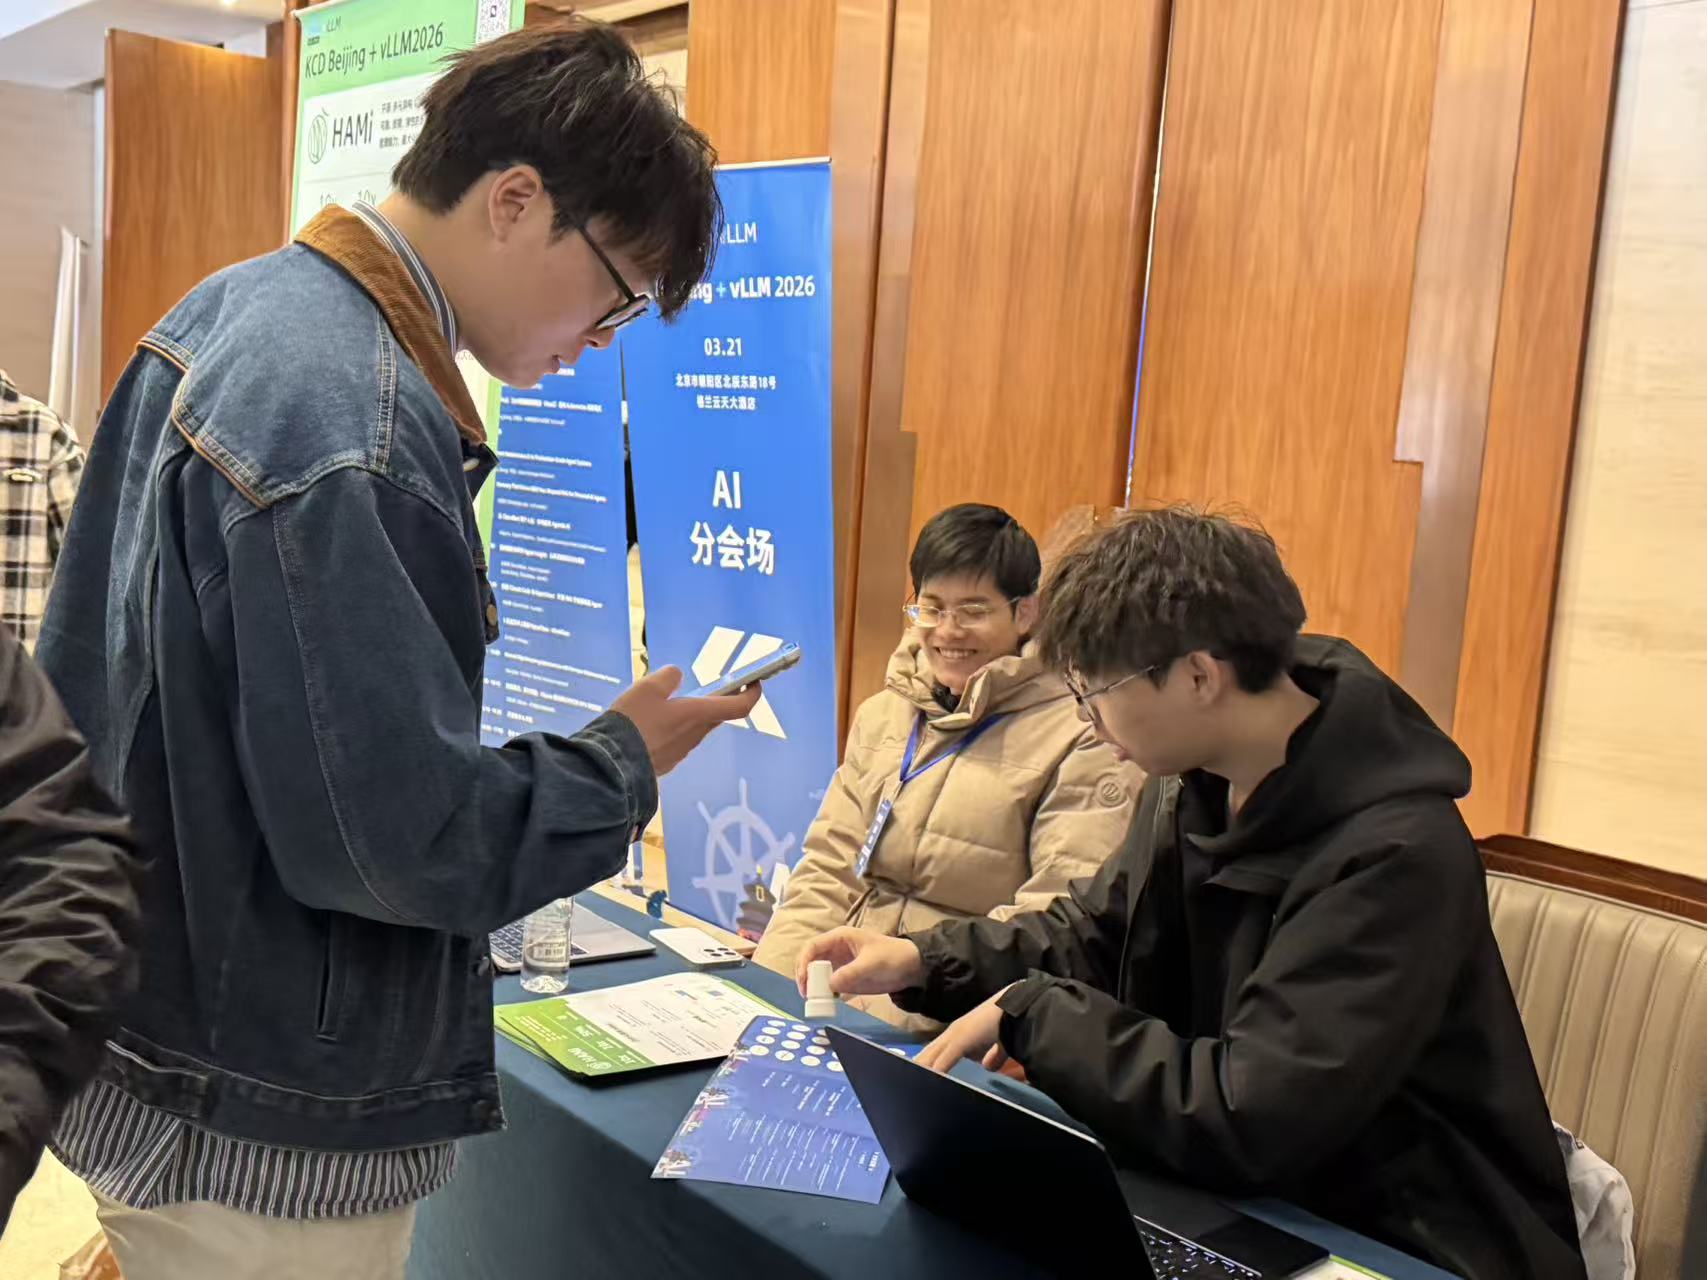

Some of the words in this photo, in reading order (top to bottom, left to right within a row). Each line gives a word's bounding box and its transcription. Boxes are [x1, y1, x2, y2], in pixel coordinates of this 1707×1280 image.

[305, 52, 326, 78] KCD
[328, 45, 366, 75] Beijing
[369, 44, 377, 62] +
[380, 22, 443, 59] vLLM2026
[332, 109, 374, 148] HAMi
[729, 276, 771, 298] vLLM
[774, 275, 815, 297] 2026
[704, 337, 742, 356] 03.21
[712, 470, 741, 509] AI
[689, 520, 774, 575] 分会场
